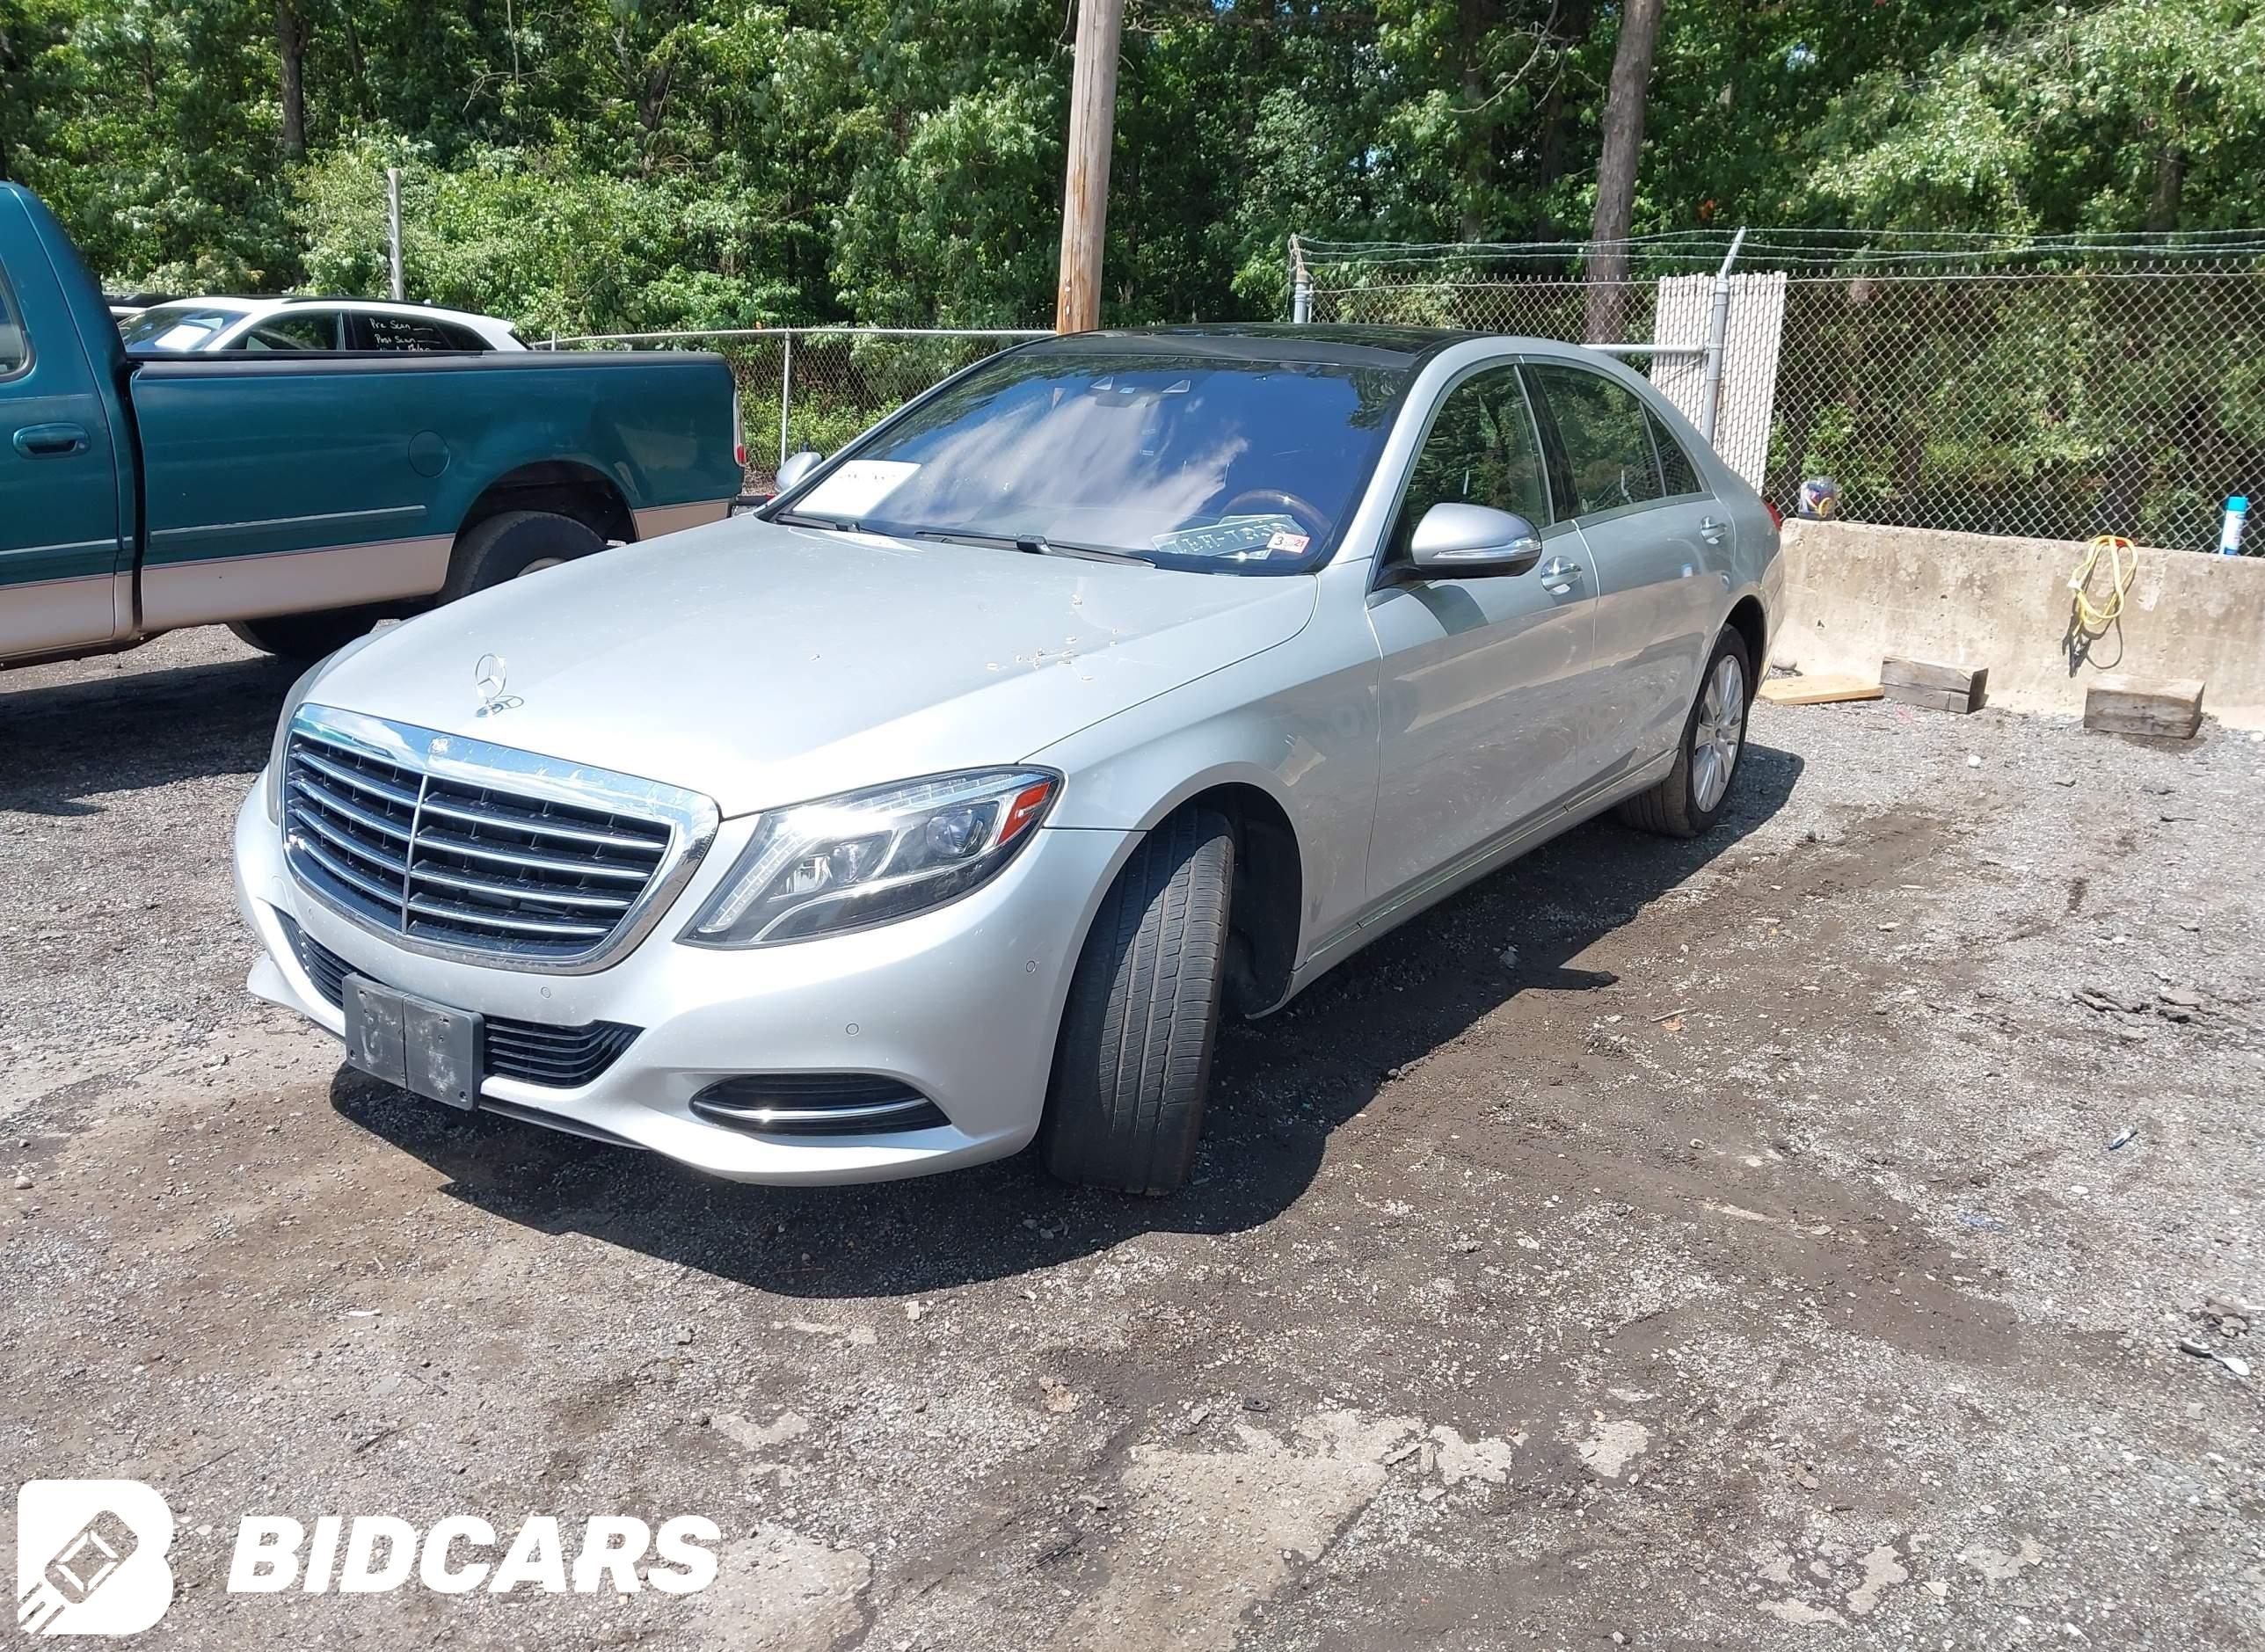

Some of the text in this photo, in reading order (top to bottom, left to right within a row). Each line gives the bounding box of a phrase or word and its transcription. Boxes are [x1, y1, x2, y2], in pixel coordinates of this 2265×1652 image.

[369, 317, 411, 330] Pre Scan
[1274, 536, 1284, 546] 3
